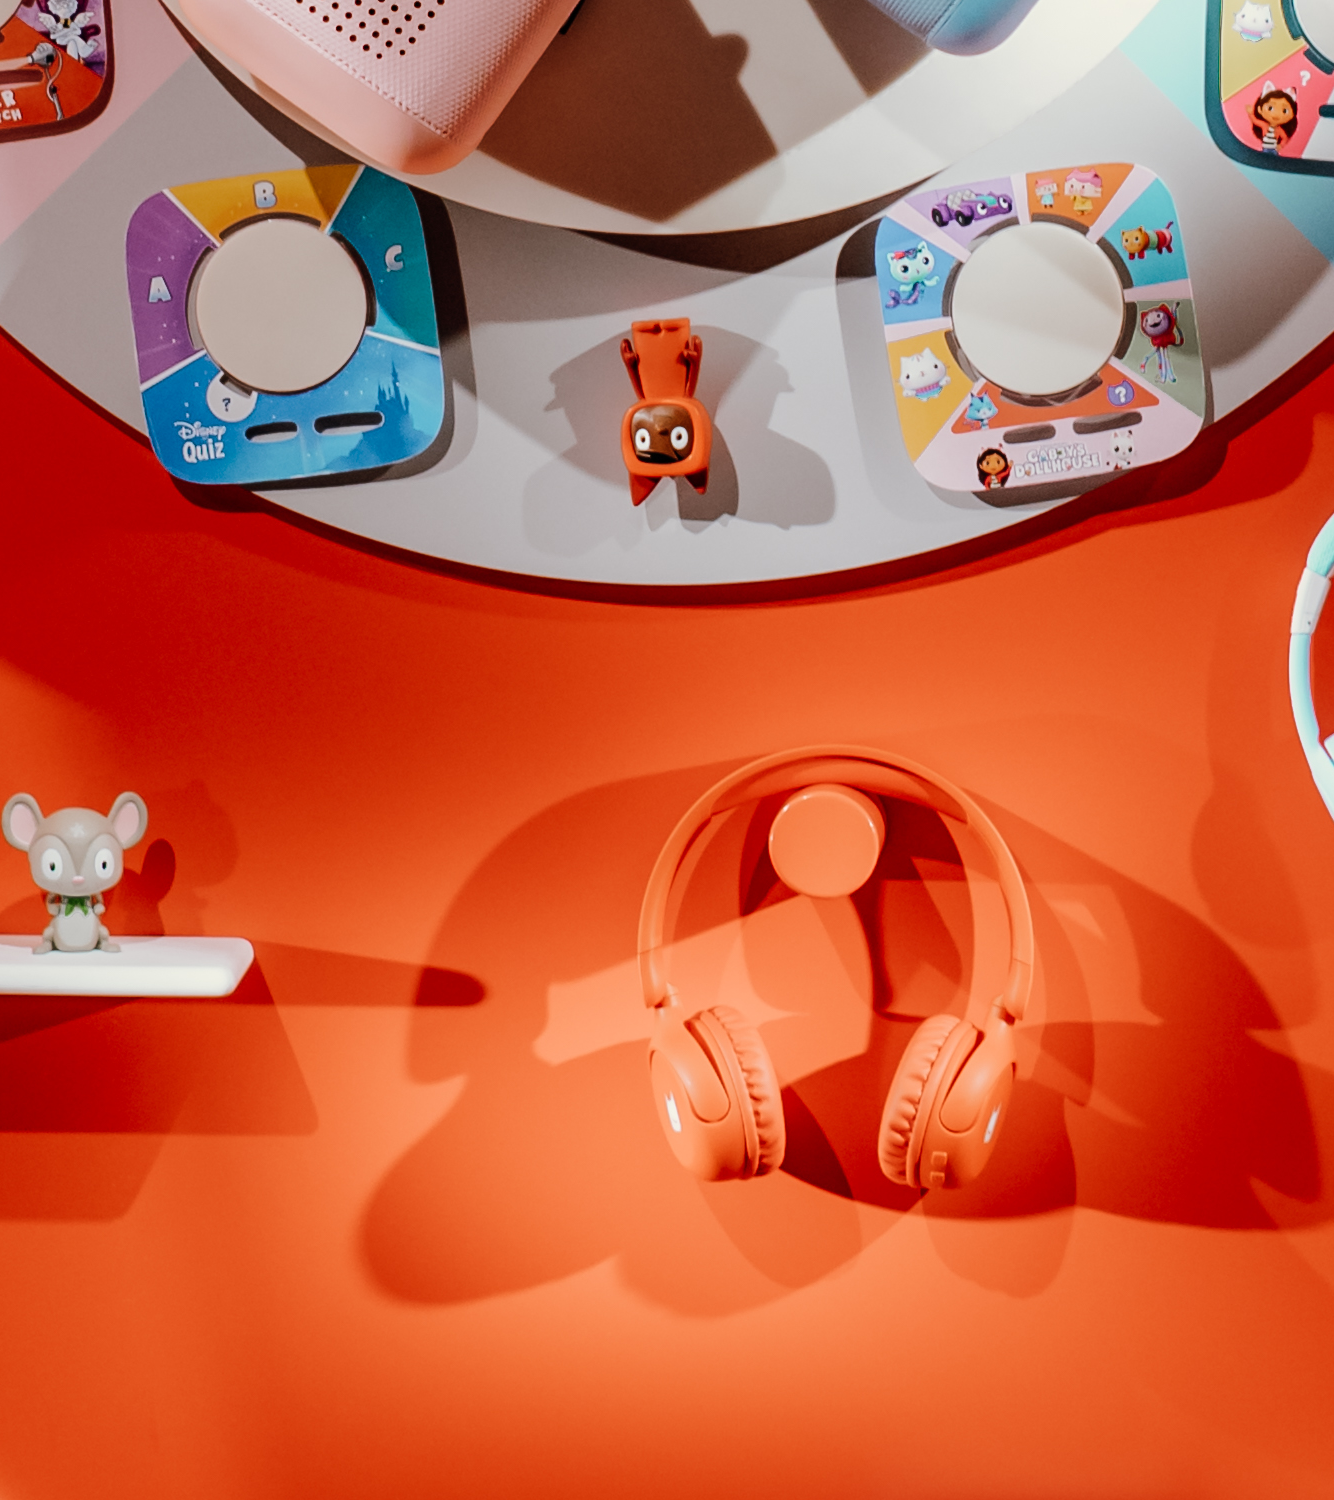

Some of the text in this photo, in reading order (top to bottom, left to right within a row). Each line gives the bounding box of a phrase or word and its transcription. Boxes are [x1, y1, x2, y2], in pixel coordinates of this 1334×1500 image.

[252, 180, 278, 209] B
[384, 244, 404, 272] C
[148, 276, 172, 303] A
[222, 397, 231, 412] ?
[1115, 386, 1127, 404] ?
[182, 438, 226, 464] Quiz
